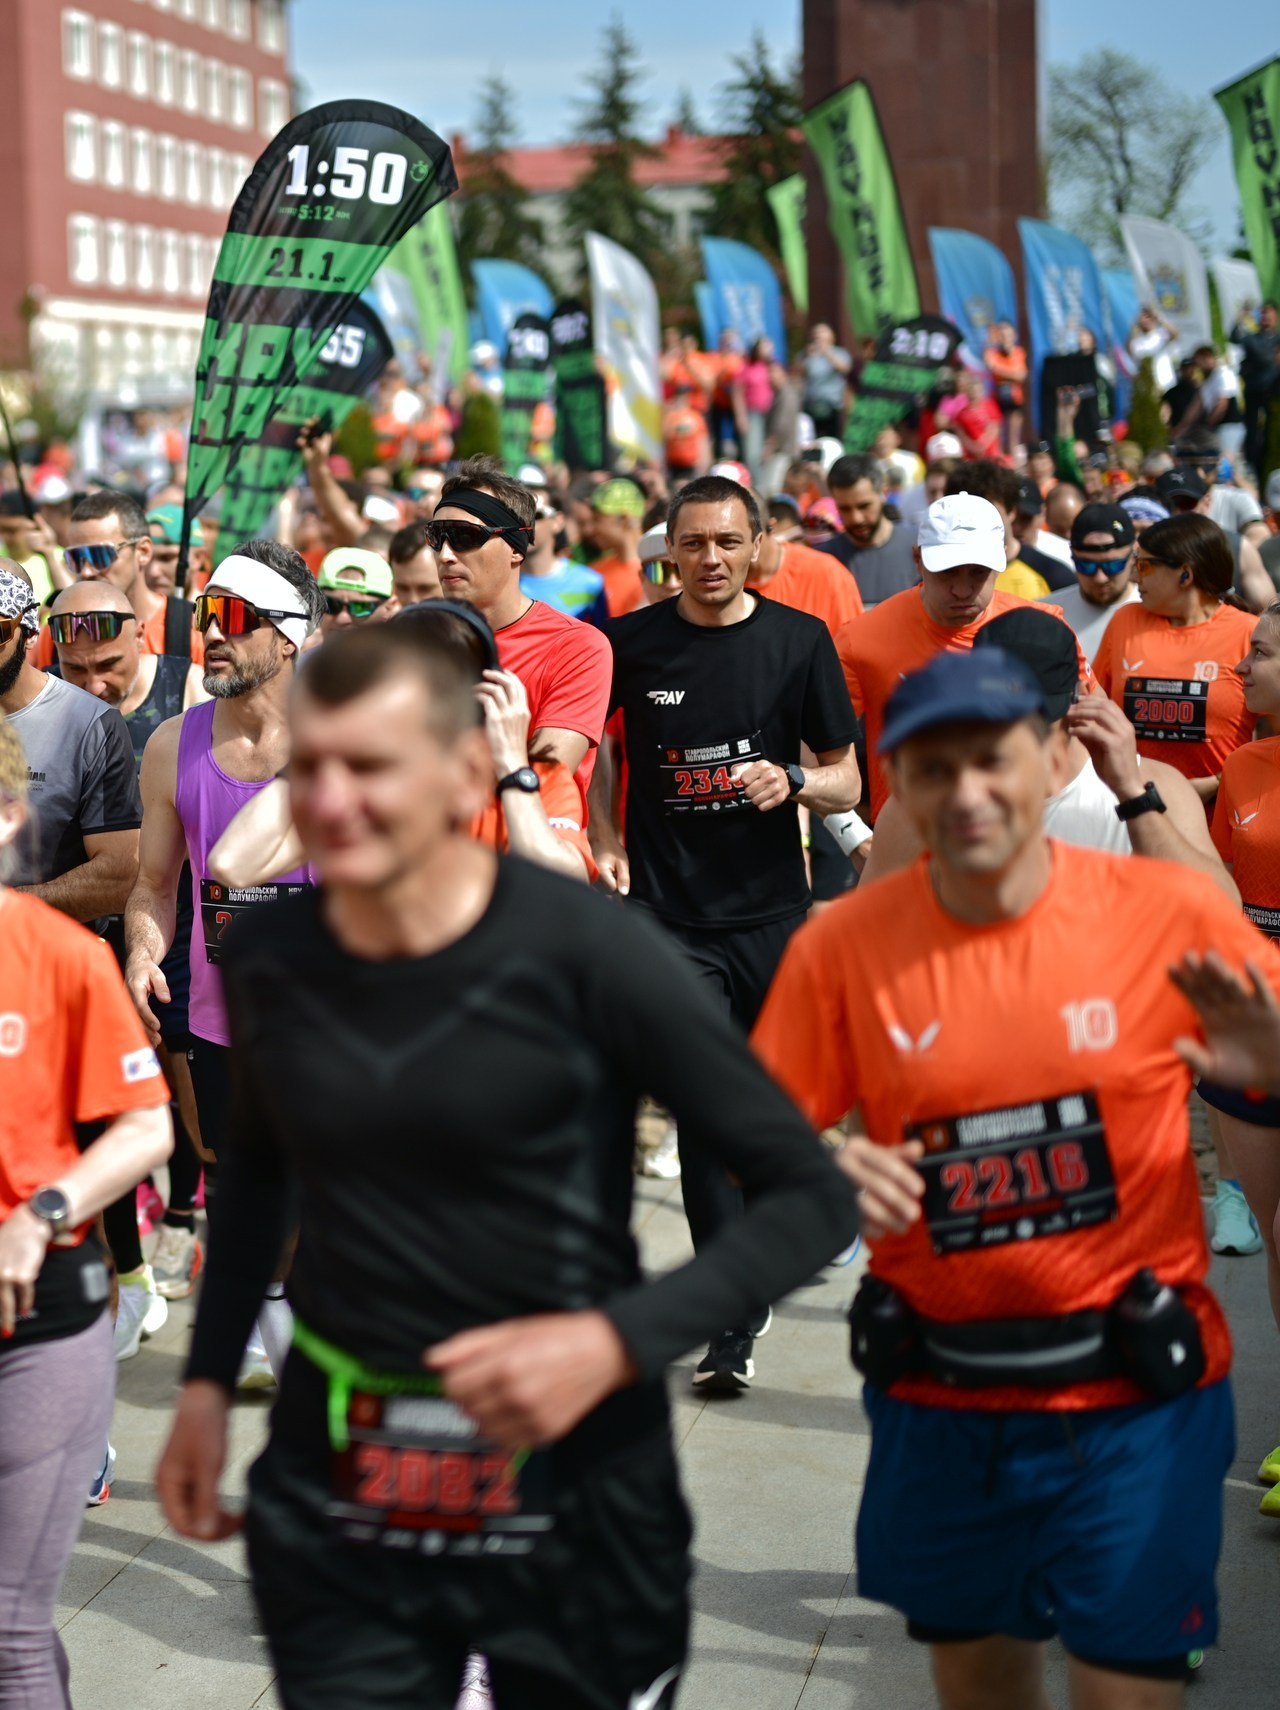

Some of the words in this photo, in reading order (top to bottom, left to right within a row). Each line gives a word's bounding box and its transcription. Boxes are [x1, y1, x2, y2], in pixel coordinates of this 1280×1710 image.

[285, 144, 407, 205] 1:50
[298, 204, 335, 221] 5:12
[266, 247, 334, 282] 21.1
[319, 323, 366, 368] 55
[1134, 698, 1194, 724] 2000
[1061, 999, 1118, 1051] 10
[940, 1141, 1090, 1213] 2216
